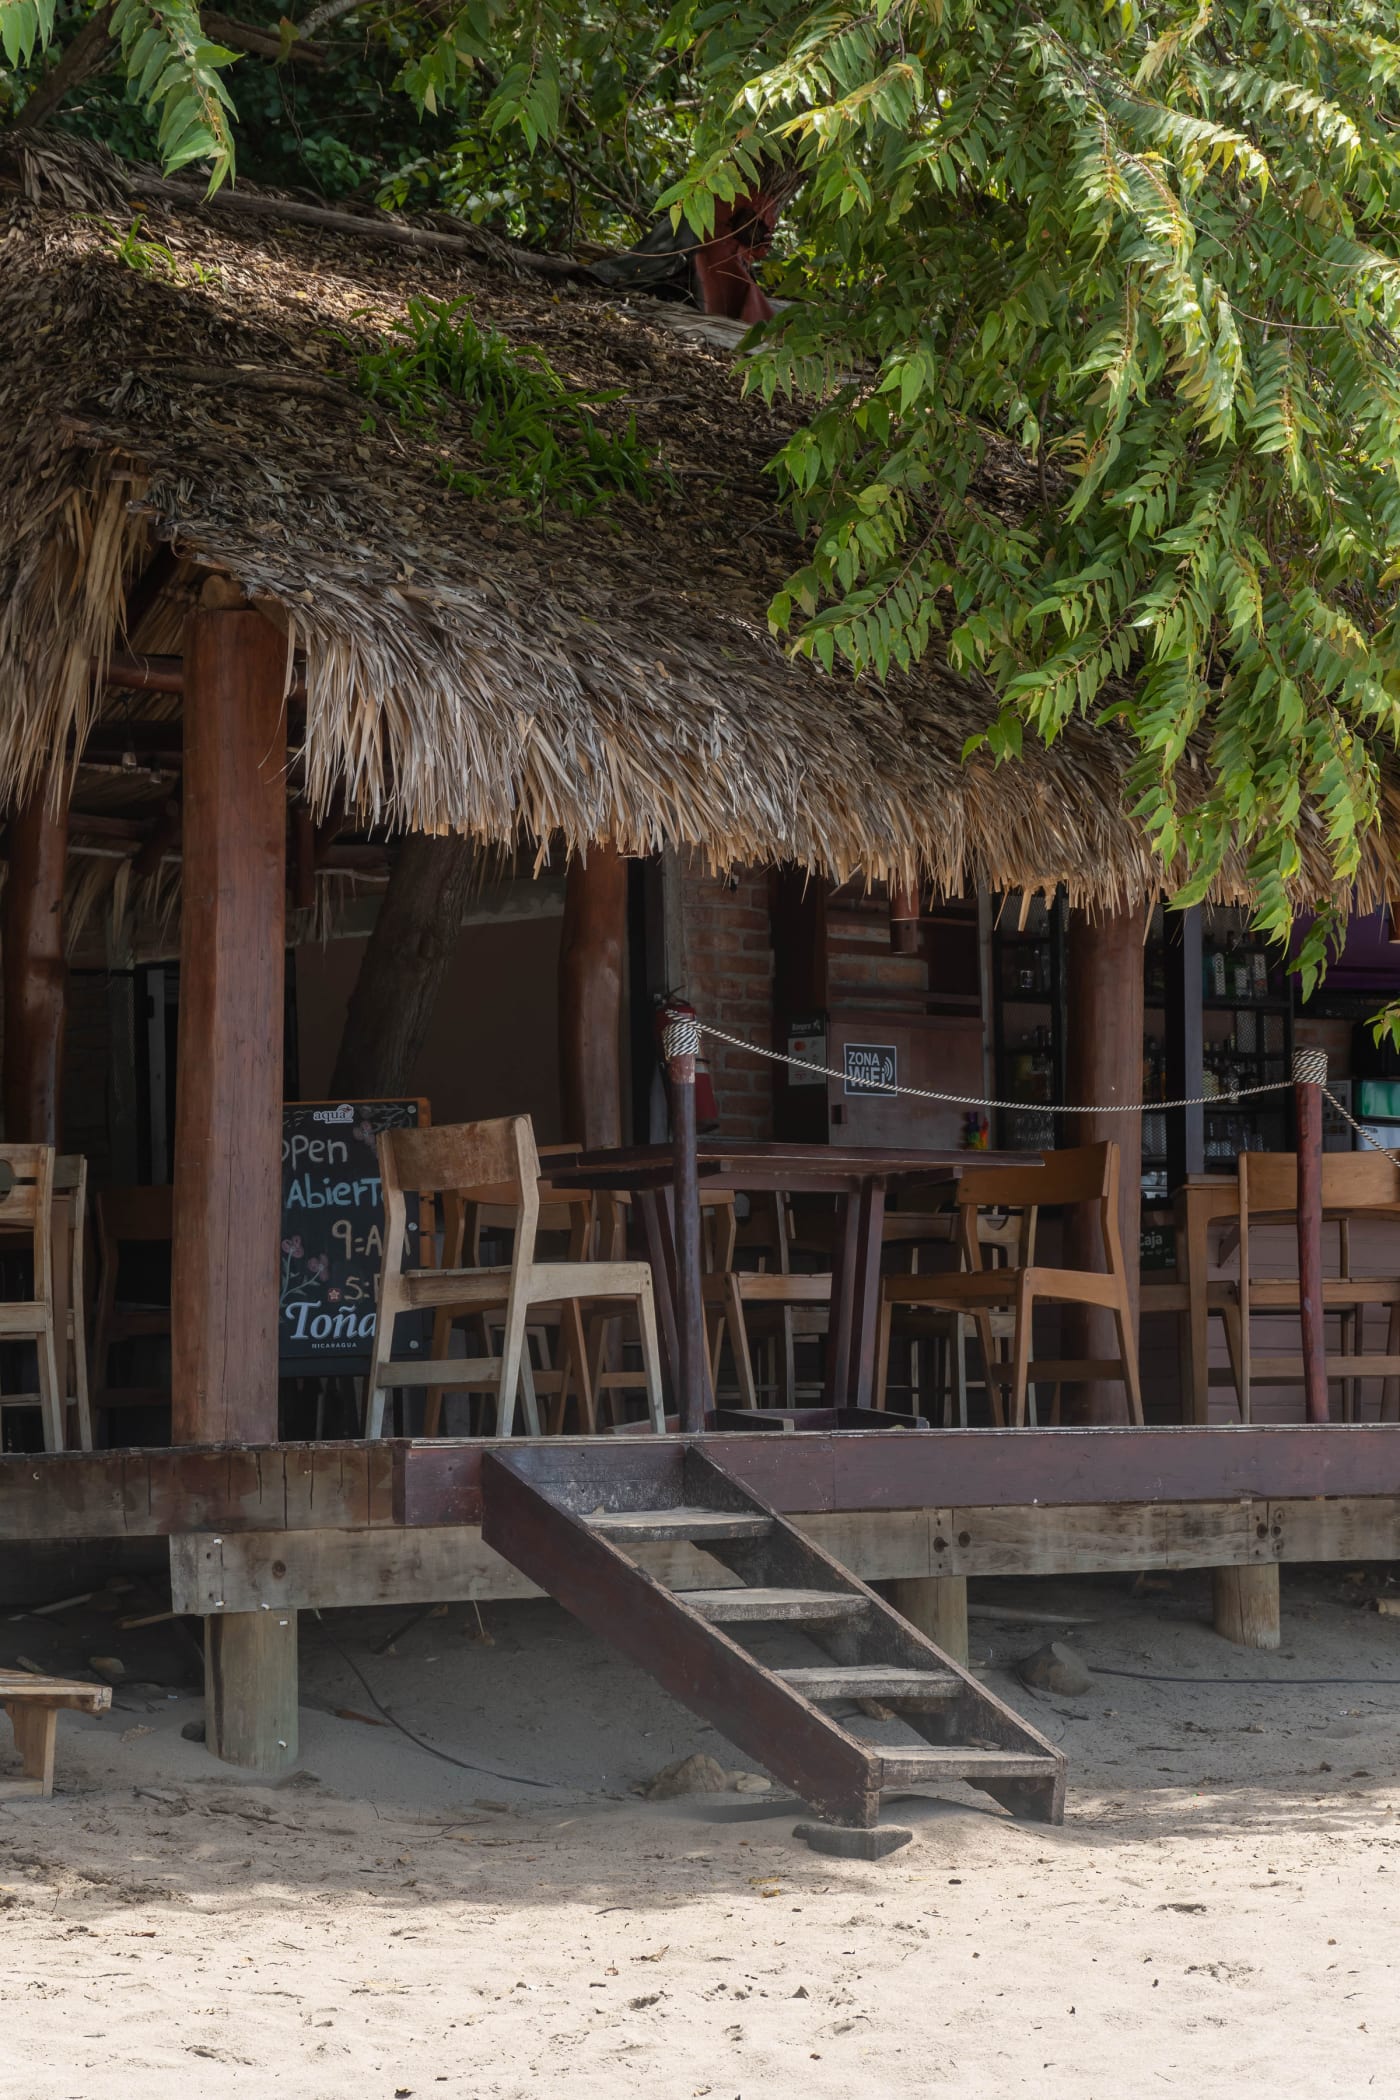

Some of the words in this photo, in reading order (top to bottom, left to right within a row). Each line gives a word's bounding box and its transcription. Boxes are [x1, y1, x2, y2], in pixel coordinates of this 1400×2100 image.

[848, 1052, 880, 1066] ZONA
[286, 1173, 384, 1209] AbierT
[285, 1300, 377, 1340] Toña
